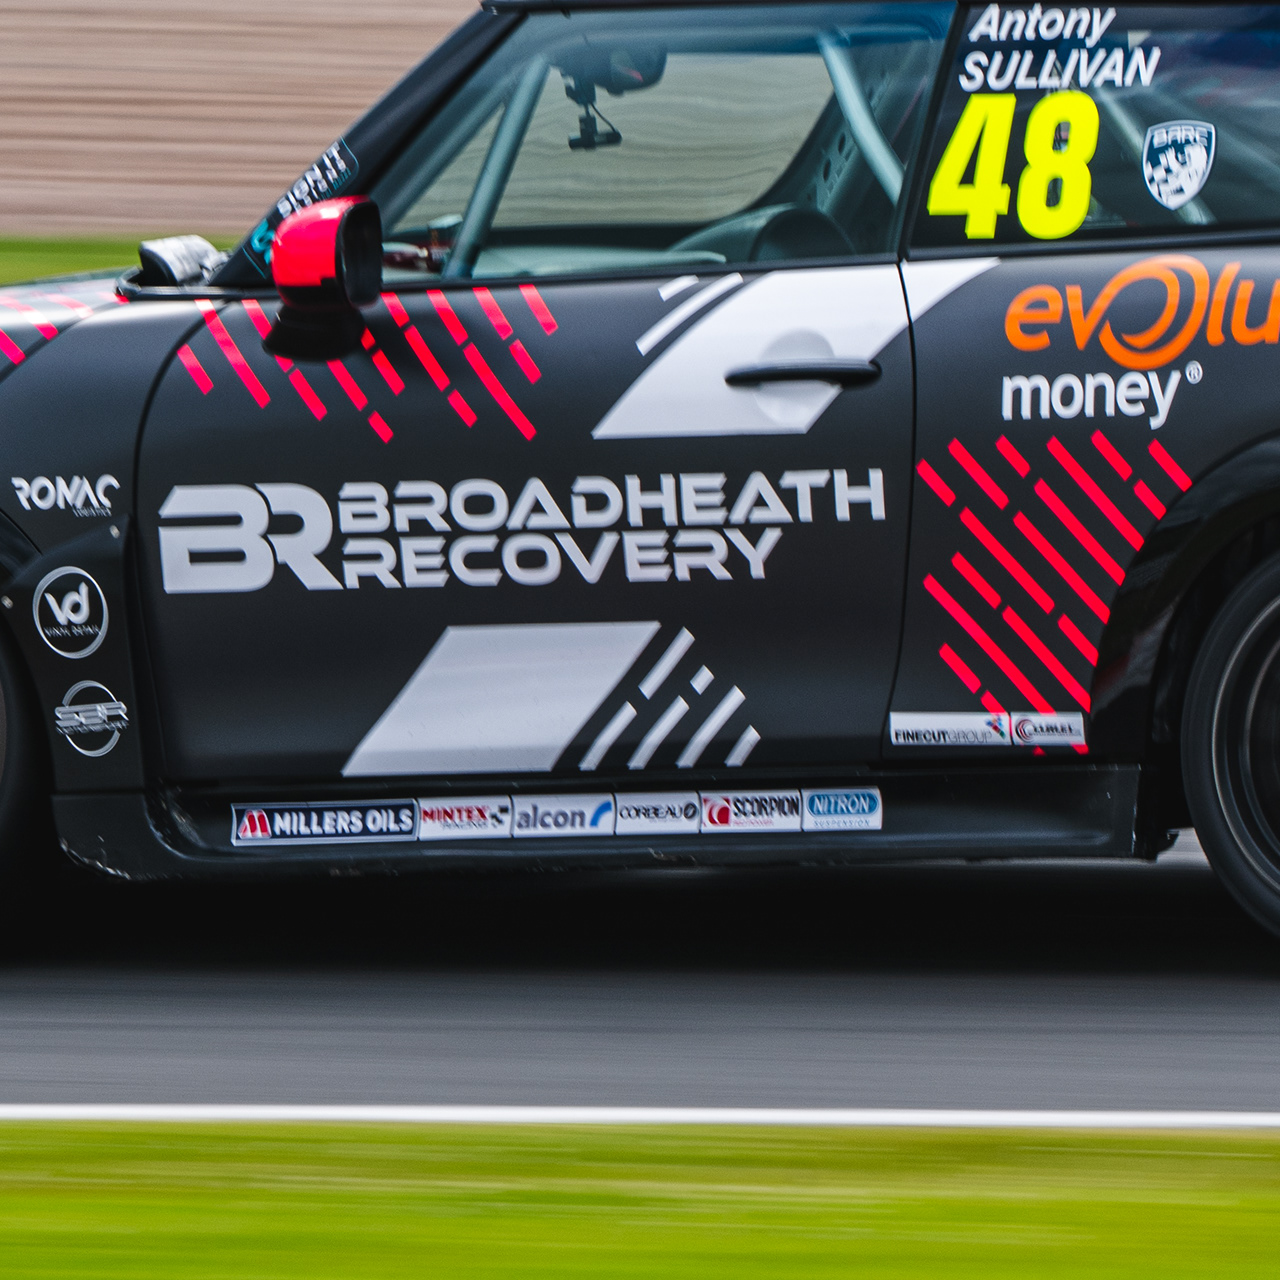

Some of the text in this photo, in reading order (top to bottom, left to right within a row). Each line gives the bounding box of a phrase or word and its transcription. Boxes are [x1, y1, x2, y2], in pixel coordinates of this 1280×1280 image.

[968, 2, 1117, 48] Antony
[958, 46, 1161, 92] SULLIVAN
[927, 90, 1100, 240] 48
[158, 468, 886, 593] BR BROADHEATH
[343, 527, 783, 589] RECOVERY
[421, 805, 490, 823] MINTEX
[516, 804, 586, 829] alcon
[619, 803, 683, 820] CORBEAU
[732, 795, 800, 819] SCORPION
[812, 792, 871, 815] NITRON
[273, 809, 364, 835] MILLERS
[368, 807, 413, 833] OILS
[813, 819, 871, 828] SUSPENSION
